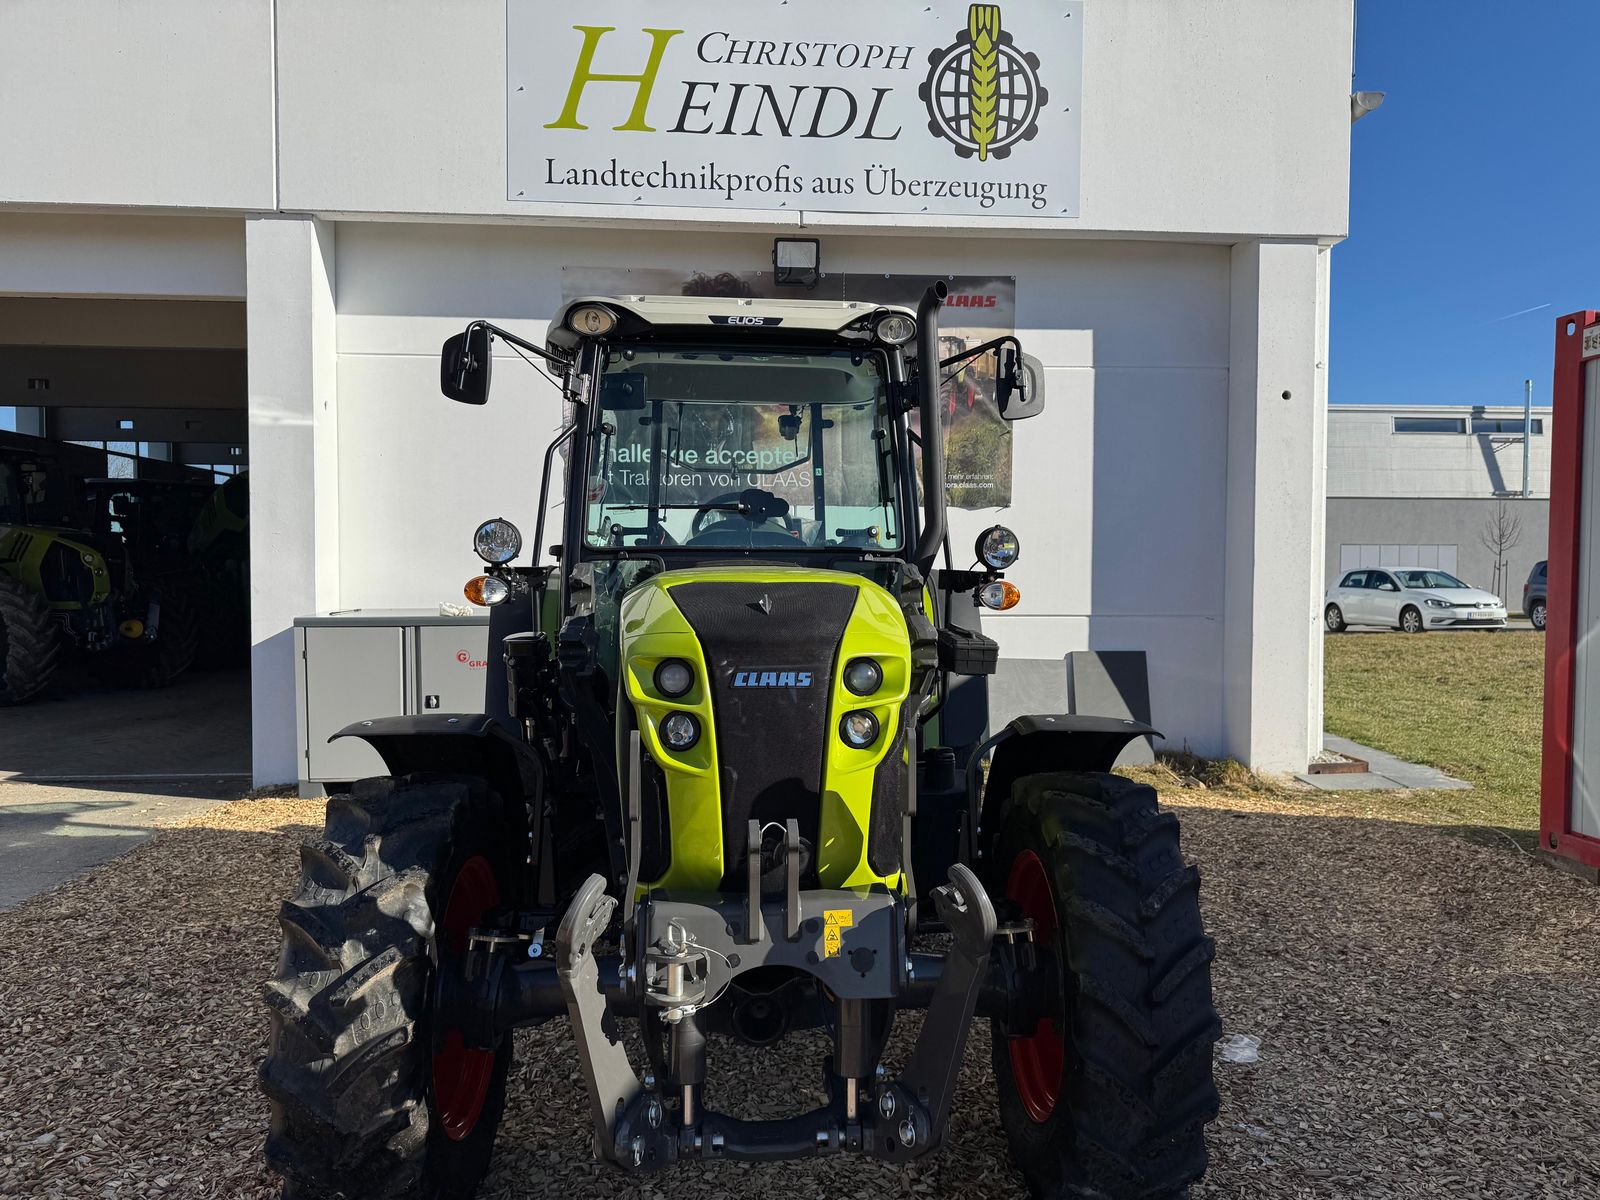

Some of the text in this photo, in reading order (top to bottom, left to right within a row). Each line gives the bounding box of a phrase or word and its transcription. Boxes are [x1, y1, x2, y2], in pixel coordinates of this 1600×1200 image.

[697, 31, 916, 71] CHRISTOPH
[542, 25, 902, 141] HEINDL
[545, 157, 1048, 210] Landtechnikprofis aus Überzeugung
[942, 295, 997, 308] LAAS
[727, 316, 765, 325] ELIOS
[599, 443, 699, 468] hallege
[747, 471, 811, 488] CLAAS
[733, 671, 812, 687] CLAAS
